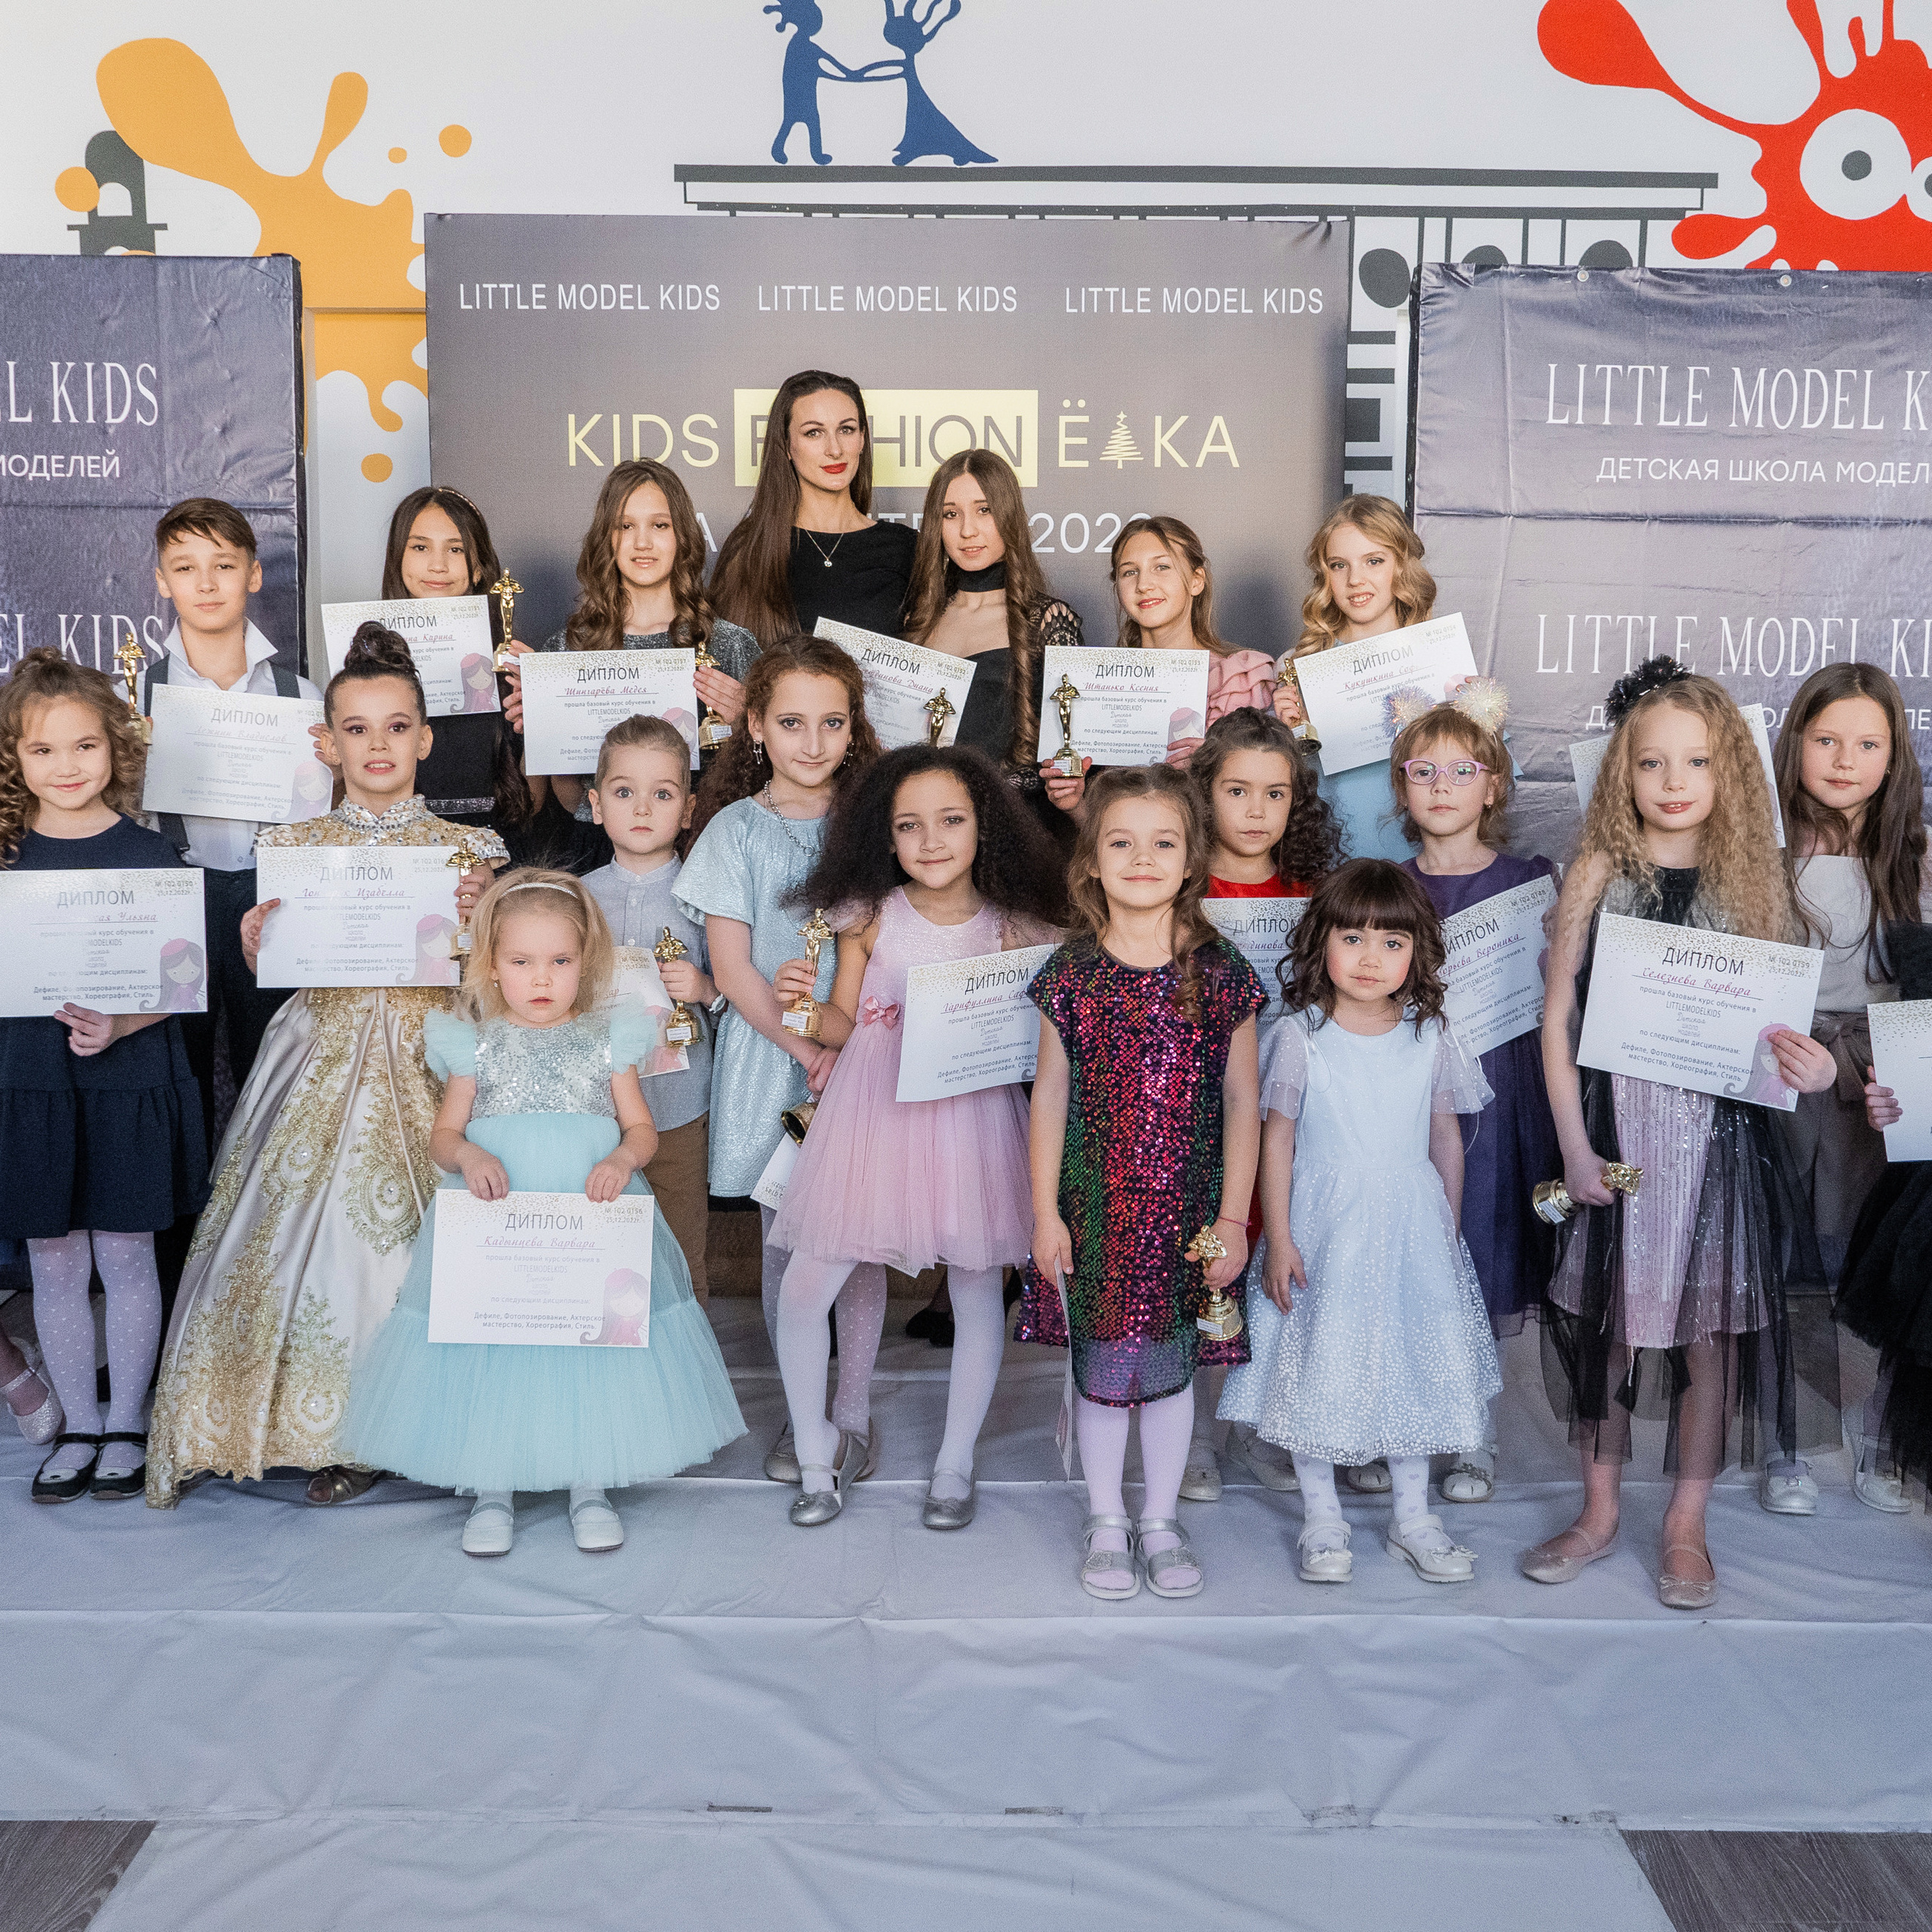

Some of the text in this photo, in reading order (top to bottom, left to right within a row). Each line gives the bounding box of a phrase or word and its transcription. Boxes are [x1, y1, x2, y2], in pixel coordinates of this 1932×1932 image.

[459, 283, 721, 311] LITTLE MODEL KIDS
[758, 285, 1017, 312] LITTLE MODEL KIDS
[1066, 287, 1324, 314] LITTLE MODEL KIDS
[50, 361, 158, 426] KIDS
[1546, 363, 1710, 428] LITTLE
[1729, 366, 1885, 430] MODEL
[568, 413, 719, 468] KIDS
[750, 414, 1023, 468] FHION
[1595, 457, 1932, 488] ДЕТСКАЯ ШКОЛА МОДЕЛ
[1027, 512, 1153, 554] 202
[57, 613, 165, 675] KIDS
[423, 632, 453, 644] Карина
[1535, 614, 1698, 674] LITTLE
[1716, 616, 1860, 678] MODEL
[860, 648, 920, 675] ДИПЛОМ
[1352, 645, 1413, 675] ДИПЛОМ
[576, 666, 639, 683] ДИПЛОМ
[1095, 664, 1155, 680] ДИПЛОМ
[1343, 670, 1394, 693] Кукушкина
[896, 691, 918, 700] обучения
[906, 678, 934, 693] Диана
[1083, 681, 1158, 691] Штанько Ксения
[1346, 691, 1367, 702] прошла
[1367, 685, 1390, 695] базовый
[211, 708, 278, 727] ДИПЛОМ
[320, 866, 392, 883] ДИПЛОМ
[57, 890, 134, 909] ДИПЛОМ
[357, 887, 405, 899] Изабелла
[118, 911, 156, 921] Ульяна
[1443, 917, 1500, 954] ИПЛОМ
[1475, 933, 1520, 960] Вероника
[1454, 967, 1479, 983] базовый
[1479, 961, 1493, 971] курс
[1493, 949, 1520, 964] обучения
[1661, 946, 1743, 975] ДИПЛОМ
[1792, 960, 1810, 969] 0159
[964, 967, 1029, 995] ДИПЛОМ
[1458, 966, 1503, 993] LITTLEMODELKIDS
[1641, 966, 1751, 998] Селезнева Варвара
[85, 992, 131, 1000] Хореография,
[942, 994, 1002, 1014] Гарифуллина
[1461, 984, 1531, 1023] следующим дисциплинам:
[1639, 985, 1665, 996] прошла
[1666, 989, 1697, 1001] базовый
[1697, 997, 1715, 1005] курс
[1715, 999, 1750, 1012] обучения
[948, 1016, 969, 1025] прошла
[971, 1010, 995, 1020] базовый
[1666, 1000, 1721, 1018] LITTLEMODELKIDS
[971, 1014, 1014, 1029] LITTLEMODELKIDS
[1469, 1006, 1518, 1035] Фотопозирование,
[1488, 1011, 1527, 1033] Хореография,
[959, 1047, 991, 1059] следующим
[992, 1039, 1032, 1051] дисциплинам:
[1649, 1031, 1690, 1044] следующим
[1690, 1039, 1739, 1054] дисциплинам:
[937, 1057, 1011, 1078] Дефиле, Фотопозирование,
[1620, 1041, 1754, 1076] Дефиле, Фотопозирование, Актерское
[1628, 1053, 1741, 1081] мастерство, Хореография, Стиль.
[943, 1072, 977, 1084] мастерство,
[977, 1063, 1015, 1075] Хореография,
[504, 1213, 583, 1233] ДИПЛОМ
[484, 1235, 595, 1251] Кадынцева Варвара
[514, 1264, 567, 1273] LITTLEMODELKIDS
[473, 1312, 502, 1320] Дефиле,
[503, 1312, 568, 1321] Фотопозирование,
[482, 1321, 524, 1329] мастерство,
[525, 1321, 573, 1330] Хореография,
